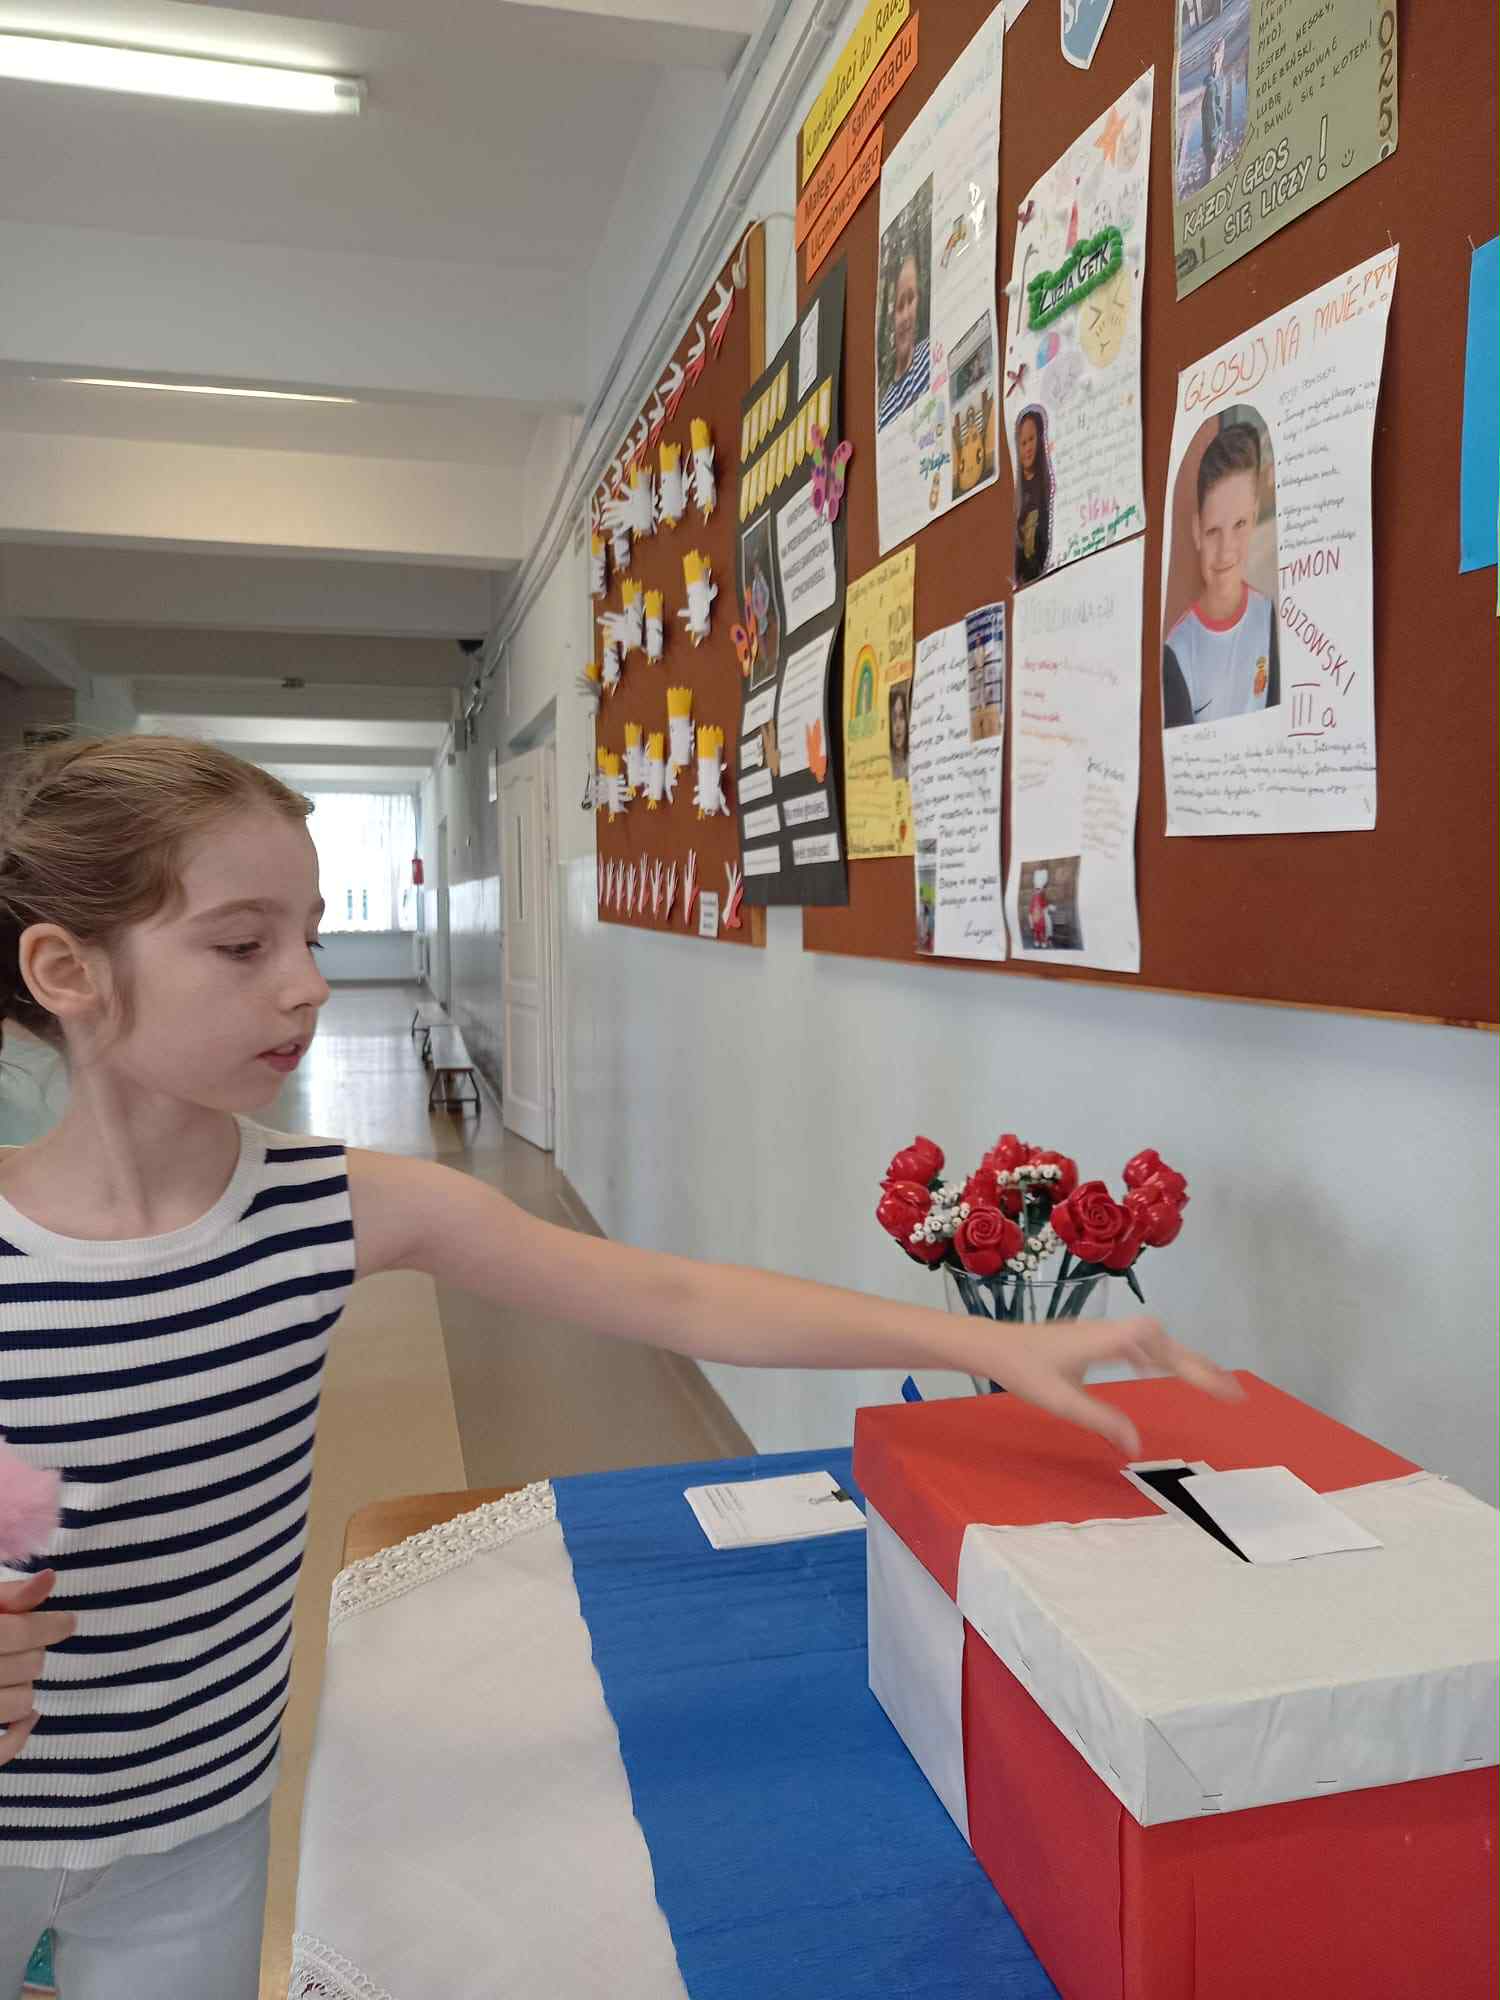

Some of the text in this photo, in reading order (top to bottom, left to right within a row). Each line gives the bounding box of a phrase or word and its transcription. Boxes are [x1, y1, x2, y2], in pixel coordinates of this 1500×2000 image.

[859, 35, 872, 73] do
[851, 33, 913, 147] Samorządu
[1273, 315, 1301, 369] NA
[1279, 546, 1341, 590] TYMON
[1279, 596, 1356, 697] GUZOWSKI
